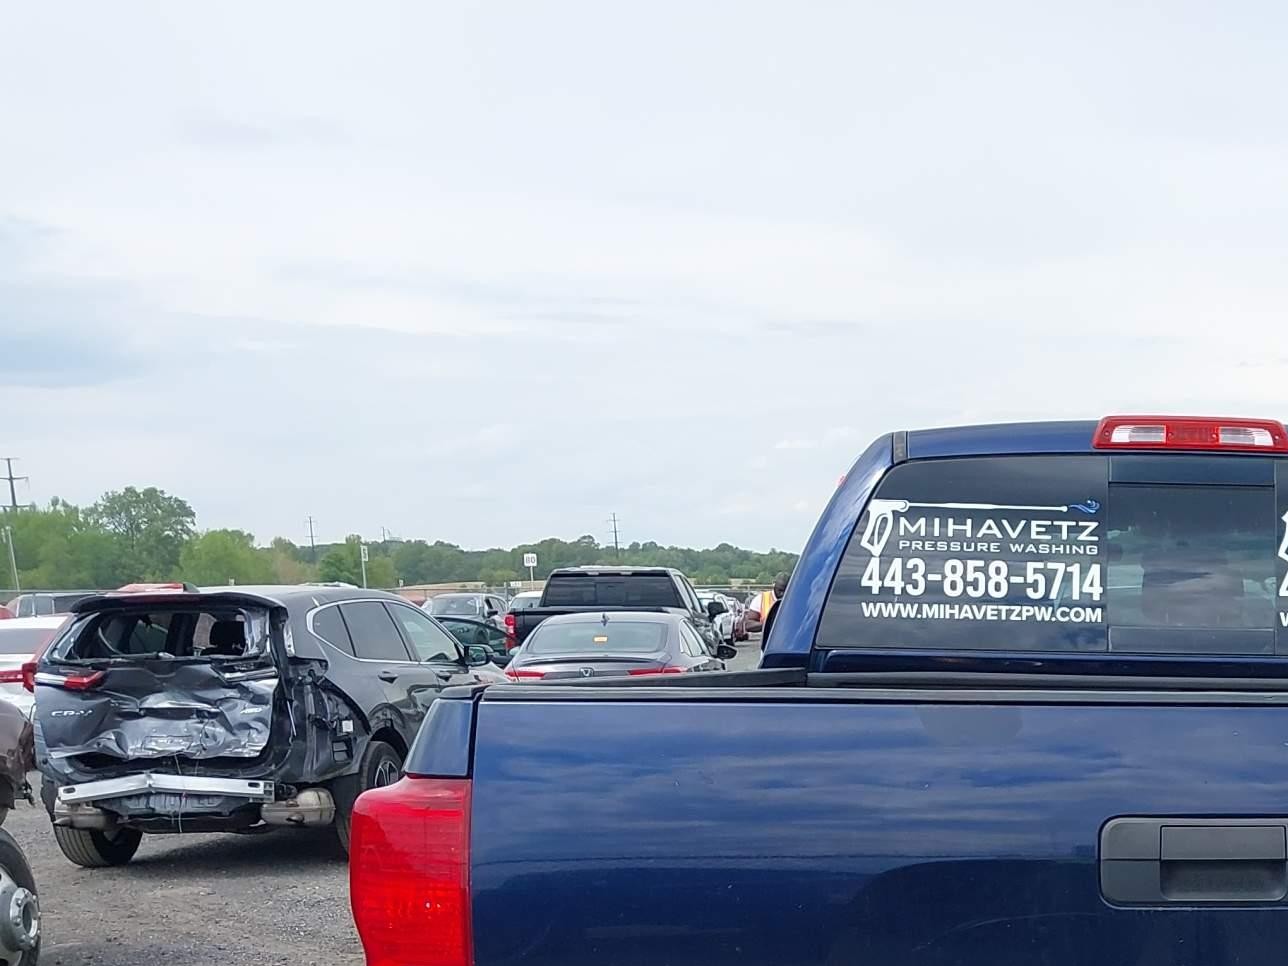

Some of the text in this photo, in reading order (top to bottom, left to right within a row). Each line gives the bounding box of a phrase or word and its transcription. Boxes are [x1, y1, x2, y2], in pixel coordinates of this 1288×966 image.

[898, 517, 1100, 542] MIHAVETZ
[898, 540, 1099, 556] PRESSURE WASHING
[860, 557, 1104, 601] 443-858-5714
[861, 602, 1103, 623] WWW.MIHAVETZPW.COM
